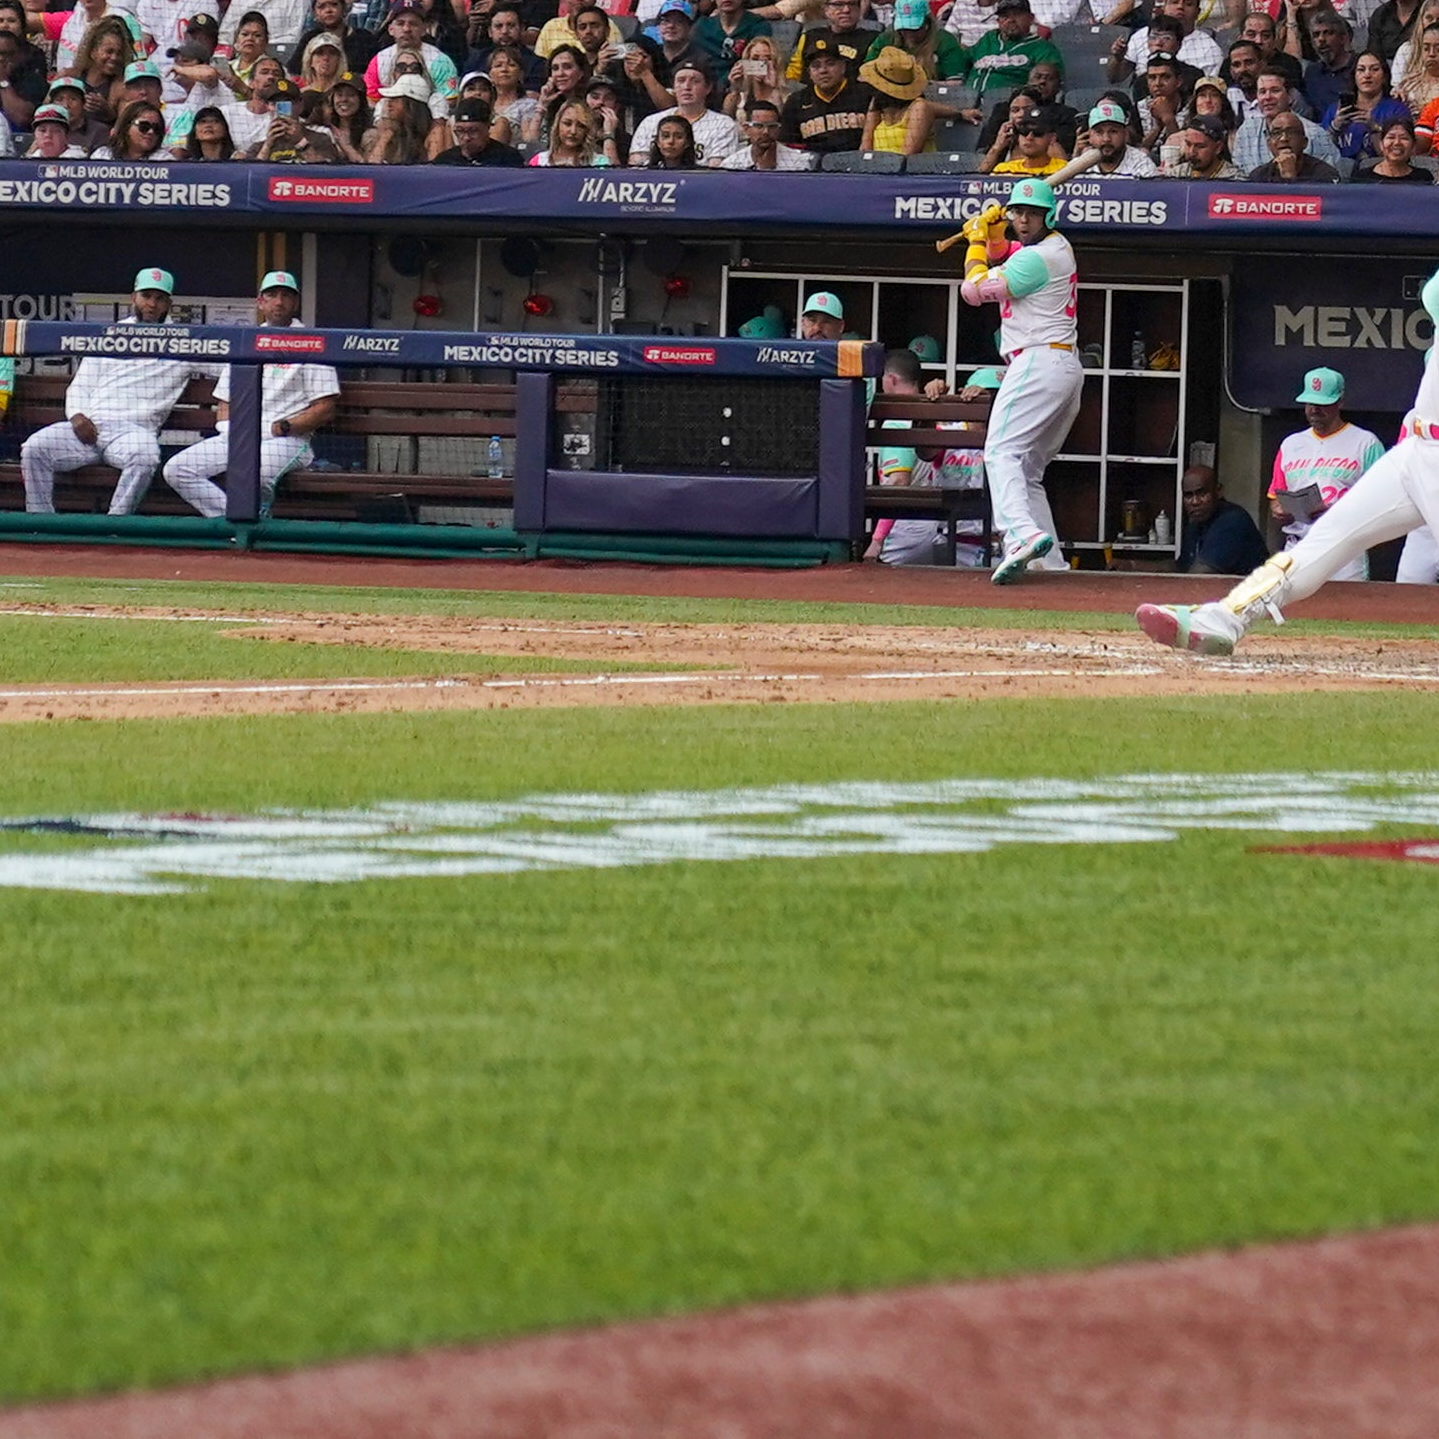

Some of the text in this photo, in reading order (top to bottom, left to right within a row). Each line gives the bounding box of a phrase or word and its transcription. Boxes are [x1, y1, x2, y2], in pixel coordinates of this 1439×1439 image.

[59, 165, 168, 179] MLB WORLD TOUR
[78, 182, 136, 204] CITY
[137, 183, 231, 206] SERIES
[294, 185, 370, 198] BANORTE
[983, 182, 1101, 196] MLB TOUR
[1067, 200, 1167, 224] SERIES
[1236, 201, 1317, 215] BANORTE
[1275, 304, 1434, 350] MEXIC
[61, 336, 230, 354] MEXICO CITY SERIES
[444, 345, 619, 366] MEXICO CITY SERIES
